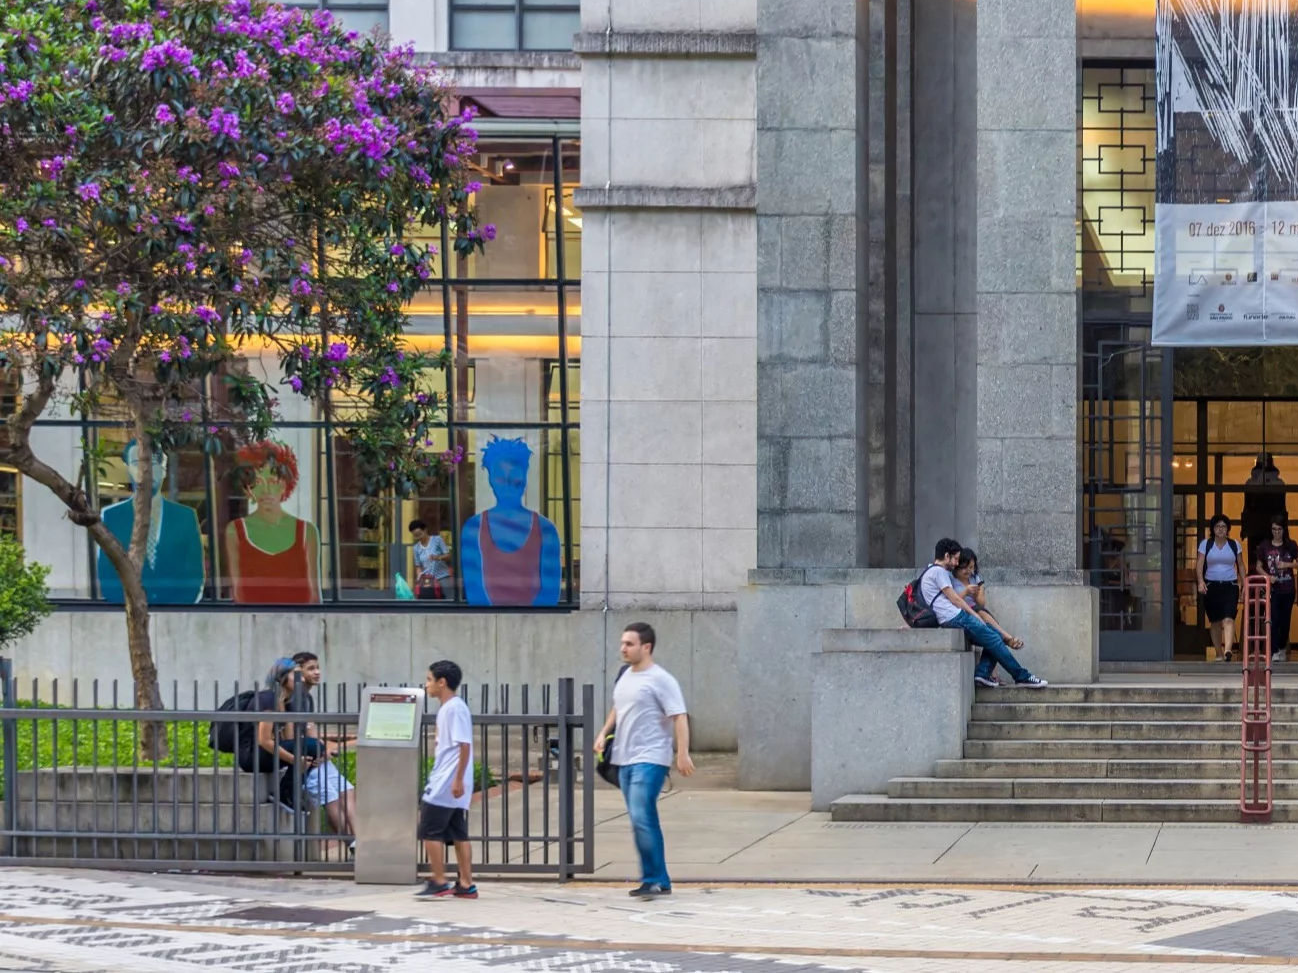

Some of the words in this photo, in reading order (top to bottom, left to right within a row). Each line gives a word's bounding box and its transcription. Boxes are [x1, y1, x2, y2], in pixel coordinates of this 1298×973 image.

[1188, 222, 1202, 237] 07
[1206, 222, 1226, 237] dez
[1228, 221, 1256, 236] 2016
[1271, 220, 1285, 235] 12
